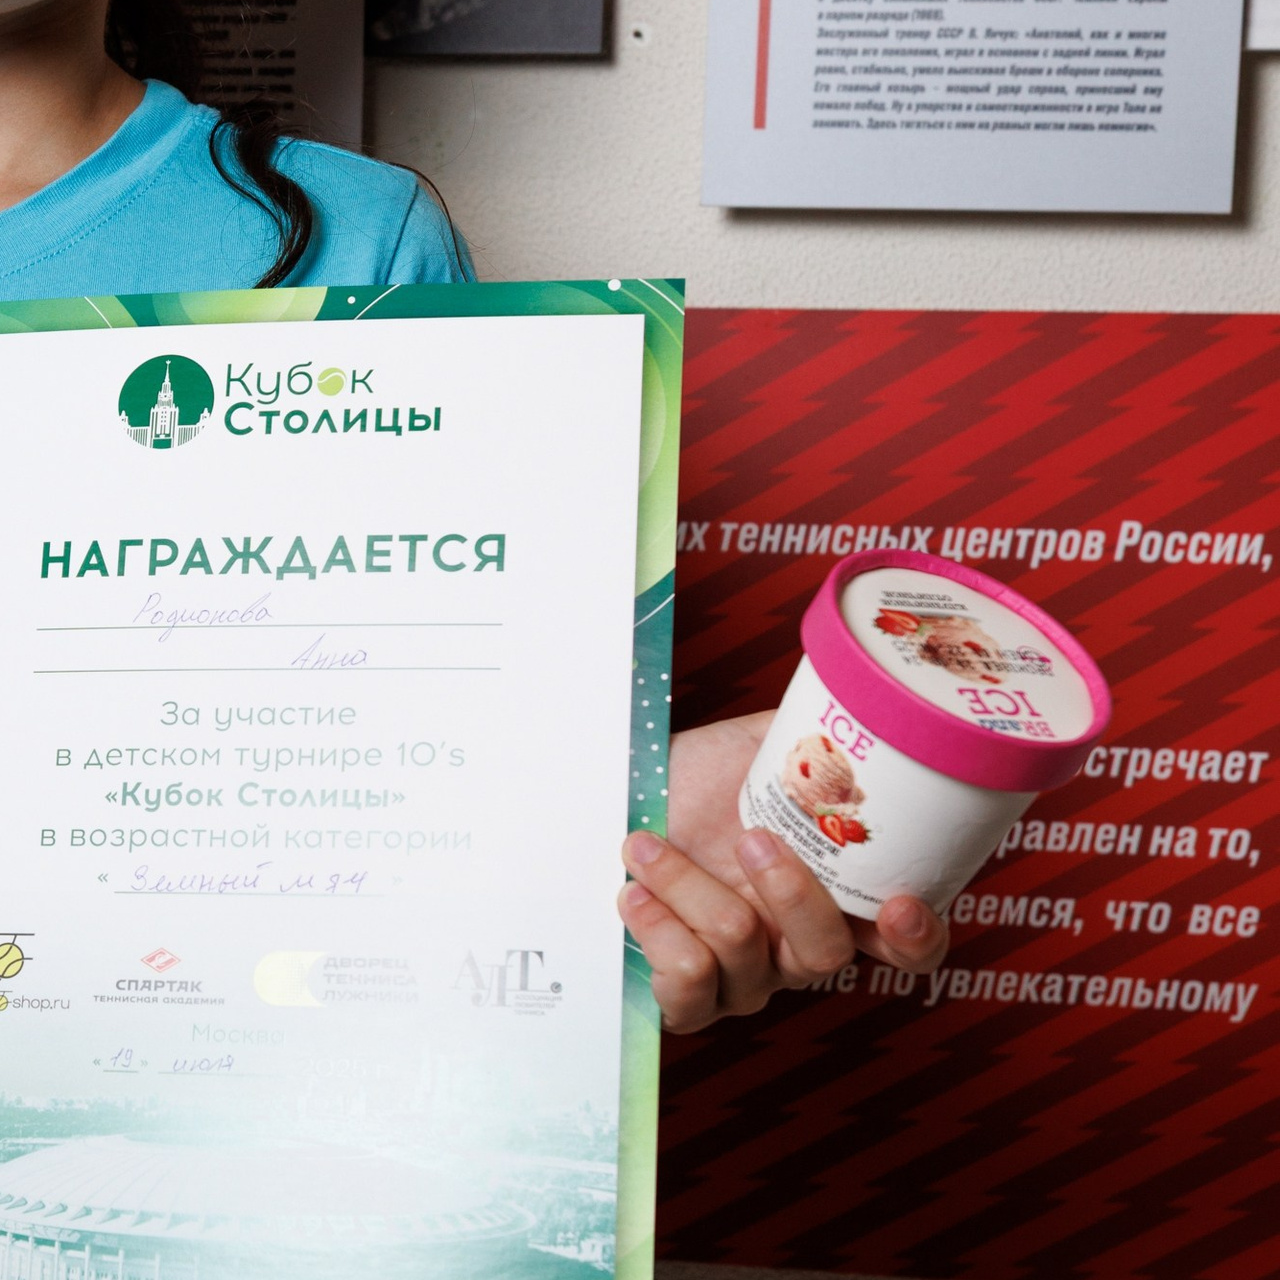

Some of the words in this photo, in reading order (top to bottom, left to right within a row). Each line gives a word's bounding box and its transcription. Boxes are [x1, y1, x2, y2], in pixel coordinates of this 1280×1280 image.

[224, 402, 442, 436] Столицы
[40, 533, 507, 580] НАГРАЖДАЕТСЯ
[719, 521, 933, 555] теннисных
[940, 525, 1105, 570] центров
[1112, 520, 1273, 573] России,
[291, 633, 368, 670] Анна
[160, 701, 201, 726] За
[214, 704, 357, 732] участие
[957, 688, 1042, 718] ICE
[818, 701, 875, 762] ICE
[55, 749, 72, 767] в
[83, 746, 222, 770] детском
[234, 746, 383, 772] турнире
[104, 781, 224, 812] «Кубок
[237, 781, 406, 812] Столицы»
[40, 830, 57, 847] в
[70, 823, 270, 852] возрастной
[284, 830, 472, 855] категории
[1149, 826, 1197, 859] на
[1209, 828, 1261, 867] то,
[1106, 900, 1171, 933] что
[1188, 904, 1261, 938] все
[323, 957, 410, 970] ДВОРЕЦ
[116, 979, 203, 993] СПАРТАК
[323, 974, 418, 987] ТЕННИСА
[924, 967, 1259, 1024] увлекательному
[322, 991, 420, 1004] ЛУЖНИКИ
[191, 1023, 286, 1046] Москва
